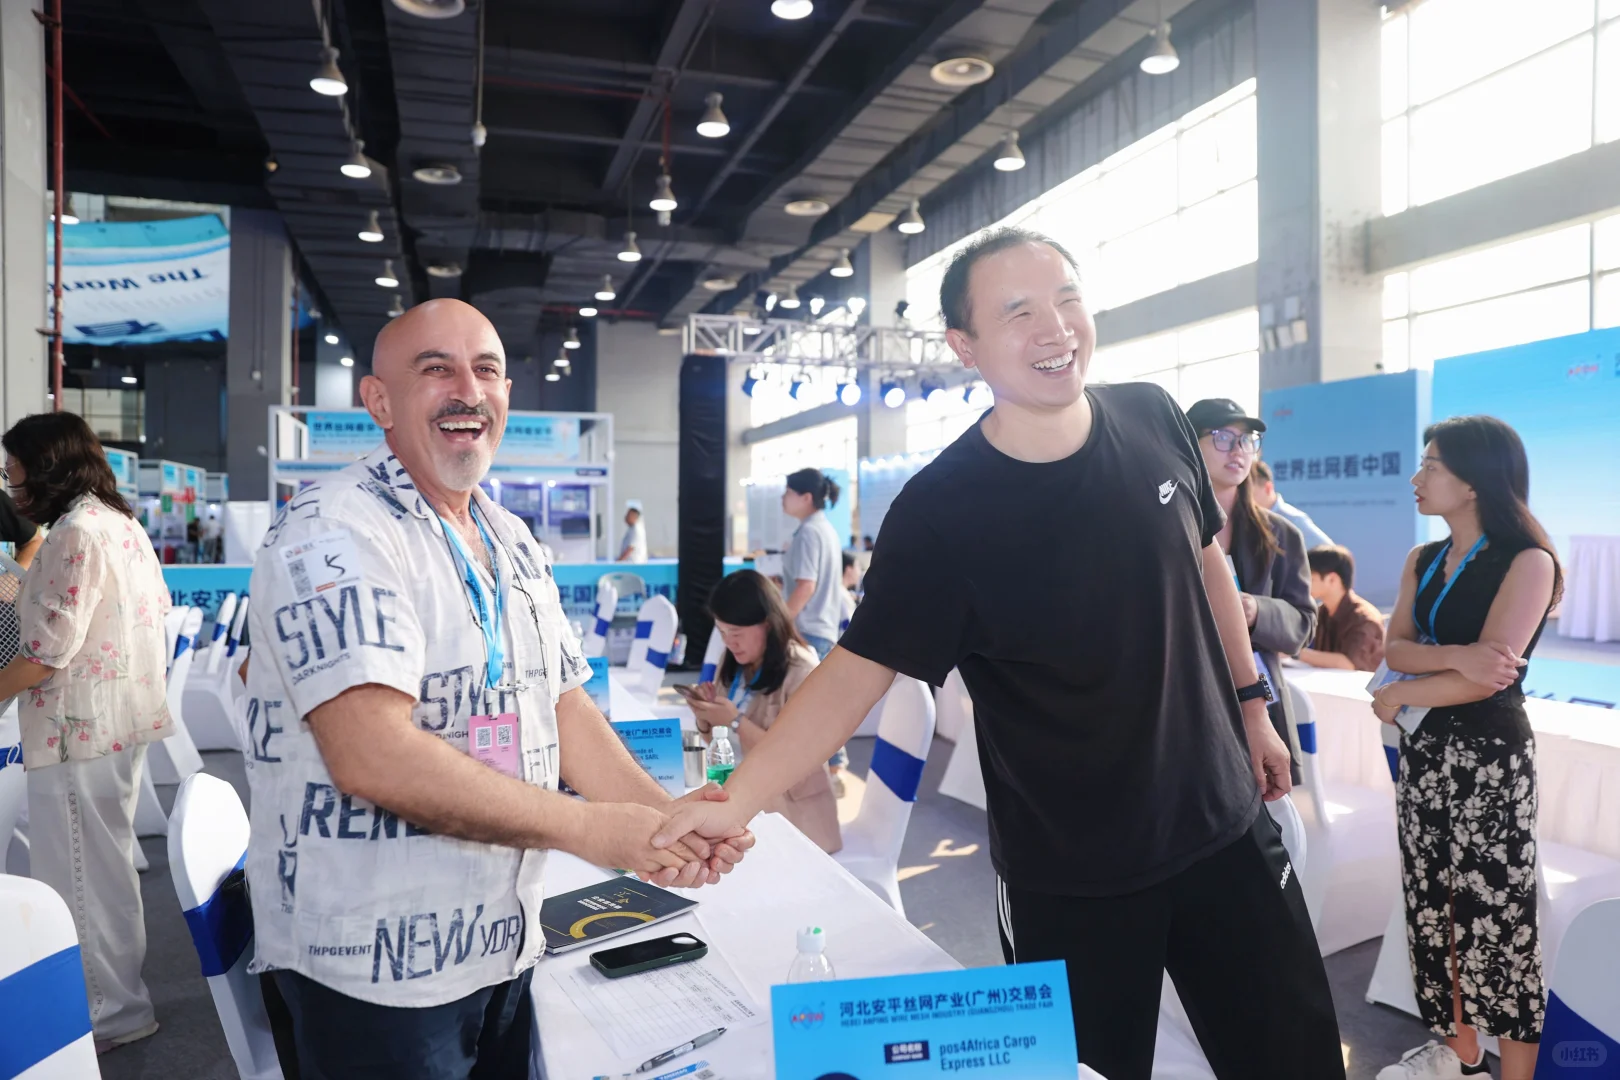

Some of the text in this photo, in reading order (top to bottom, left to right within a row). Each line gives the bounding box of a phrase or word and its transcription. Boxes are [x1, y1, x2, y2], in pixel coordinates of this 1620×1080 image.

[148, 268, 206, 283] The
[1274, 452, 1401, 481] 世界丝网看中国
[1159, 480, 1173, 497] NIKE
[274, 585, 405, 670] STYLE
[308, 904, 520, 983] THPGEVENT NEW YOR
[840, 984, 1052, 1017] 河北安平丝网产业(广州)交易会
[940, 1034, 1037, 1056] pos4Africa Cargo
[941, 1052, 1011, 1072] Express LLC
